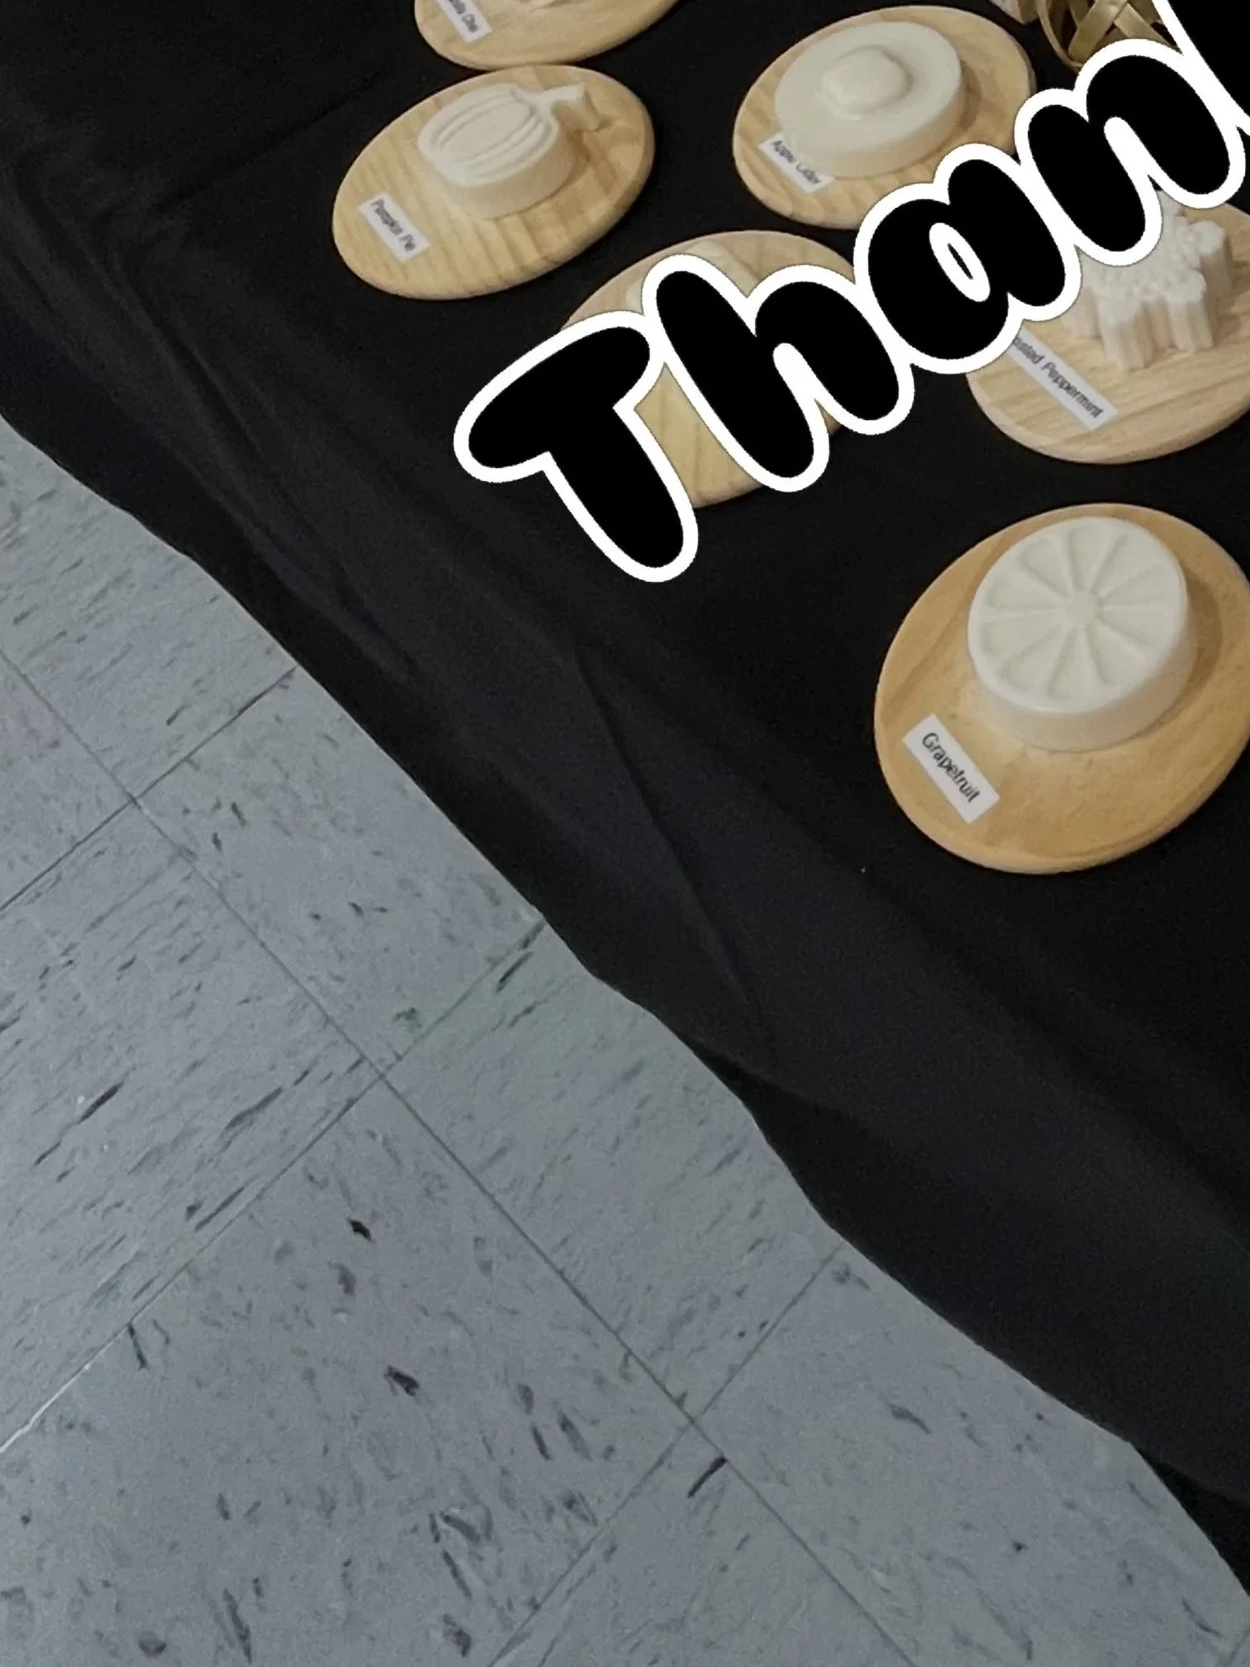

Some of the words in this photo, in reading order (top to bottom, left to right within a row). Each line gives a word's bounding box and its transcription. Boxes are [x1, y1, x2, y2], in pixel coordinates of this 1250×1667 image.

[370, 198, 404, 236] Pumpkin
[1041, 361, 1104, 419] Peppermint
[921, 731, 981, 804] Grapefruit
